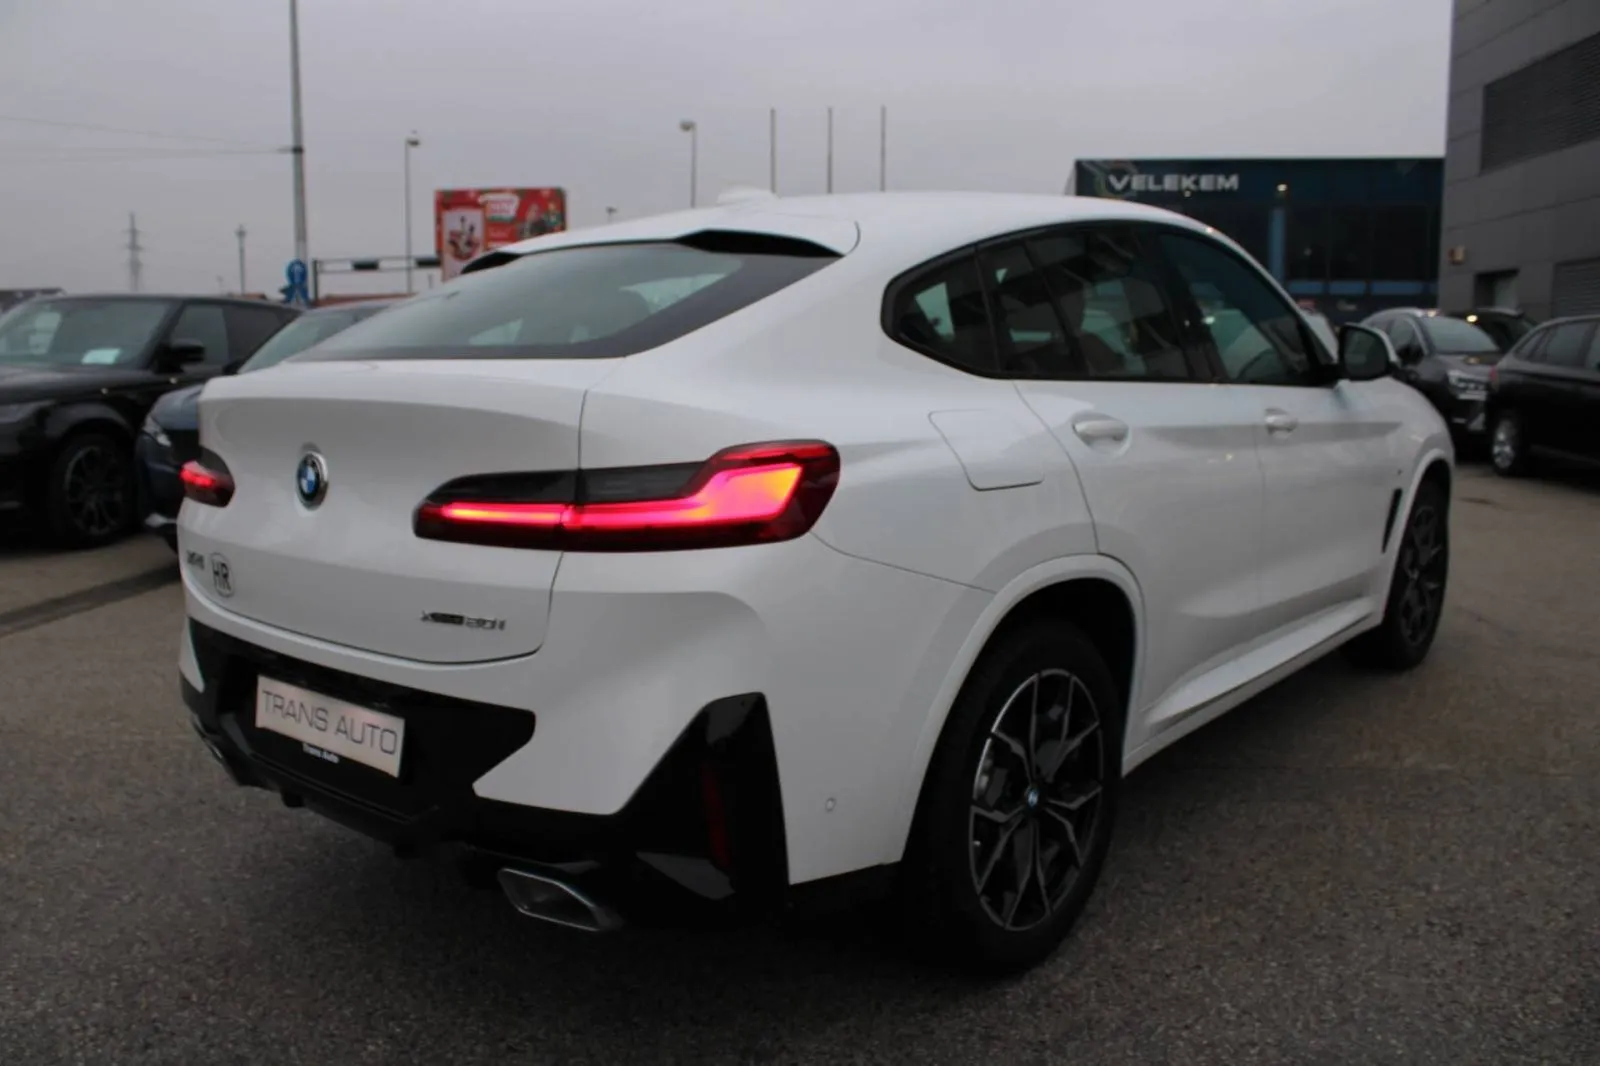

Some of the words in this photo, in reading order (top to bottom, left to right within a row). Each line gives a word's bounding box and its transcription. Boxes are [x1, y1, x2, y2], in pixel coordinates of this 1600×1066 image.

[1108, 174, 1239, 191] VELEKEM
[211, 558, 231, 591] HR
[262, 689, 329, 732] TRANS
[334, 715, 398, 755] AUTO
